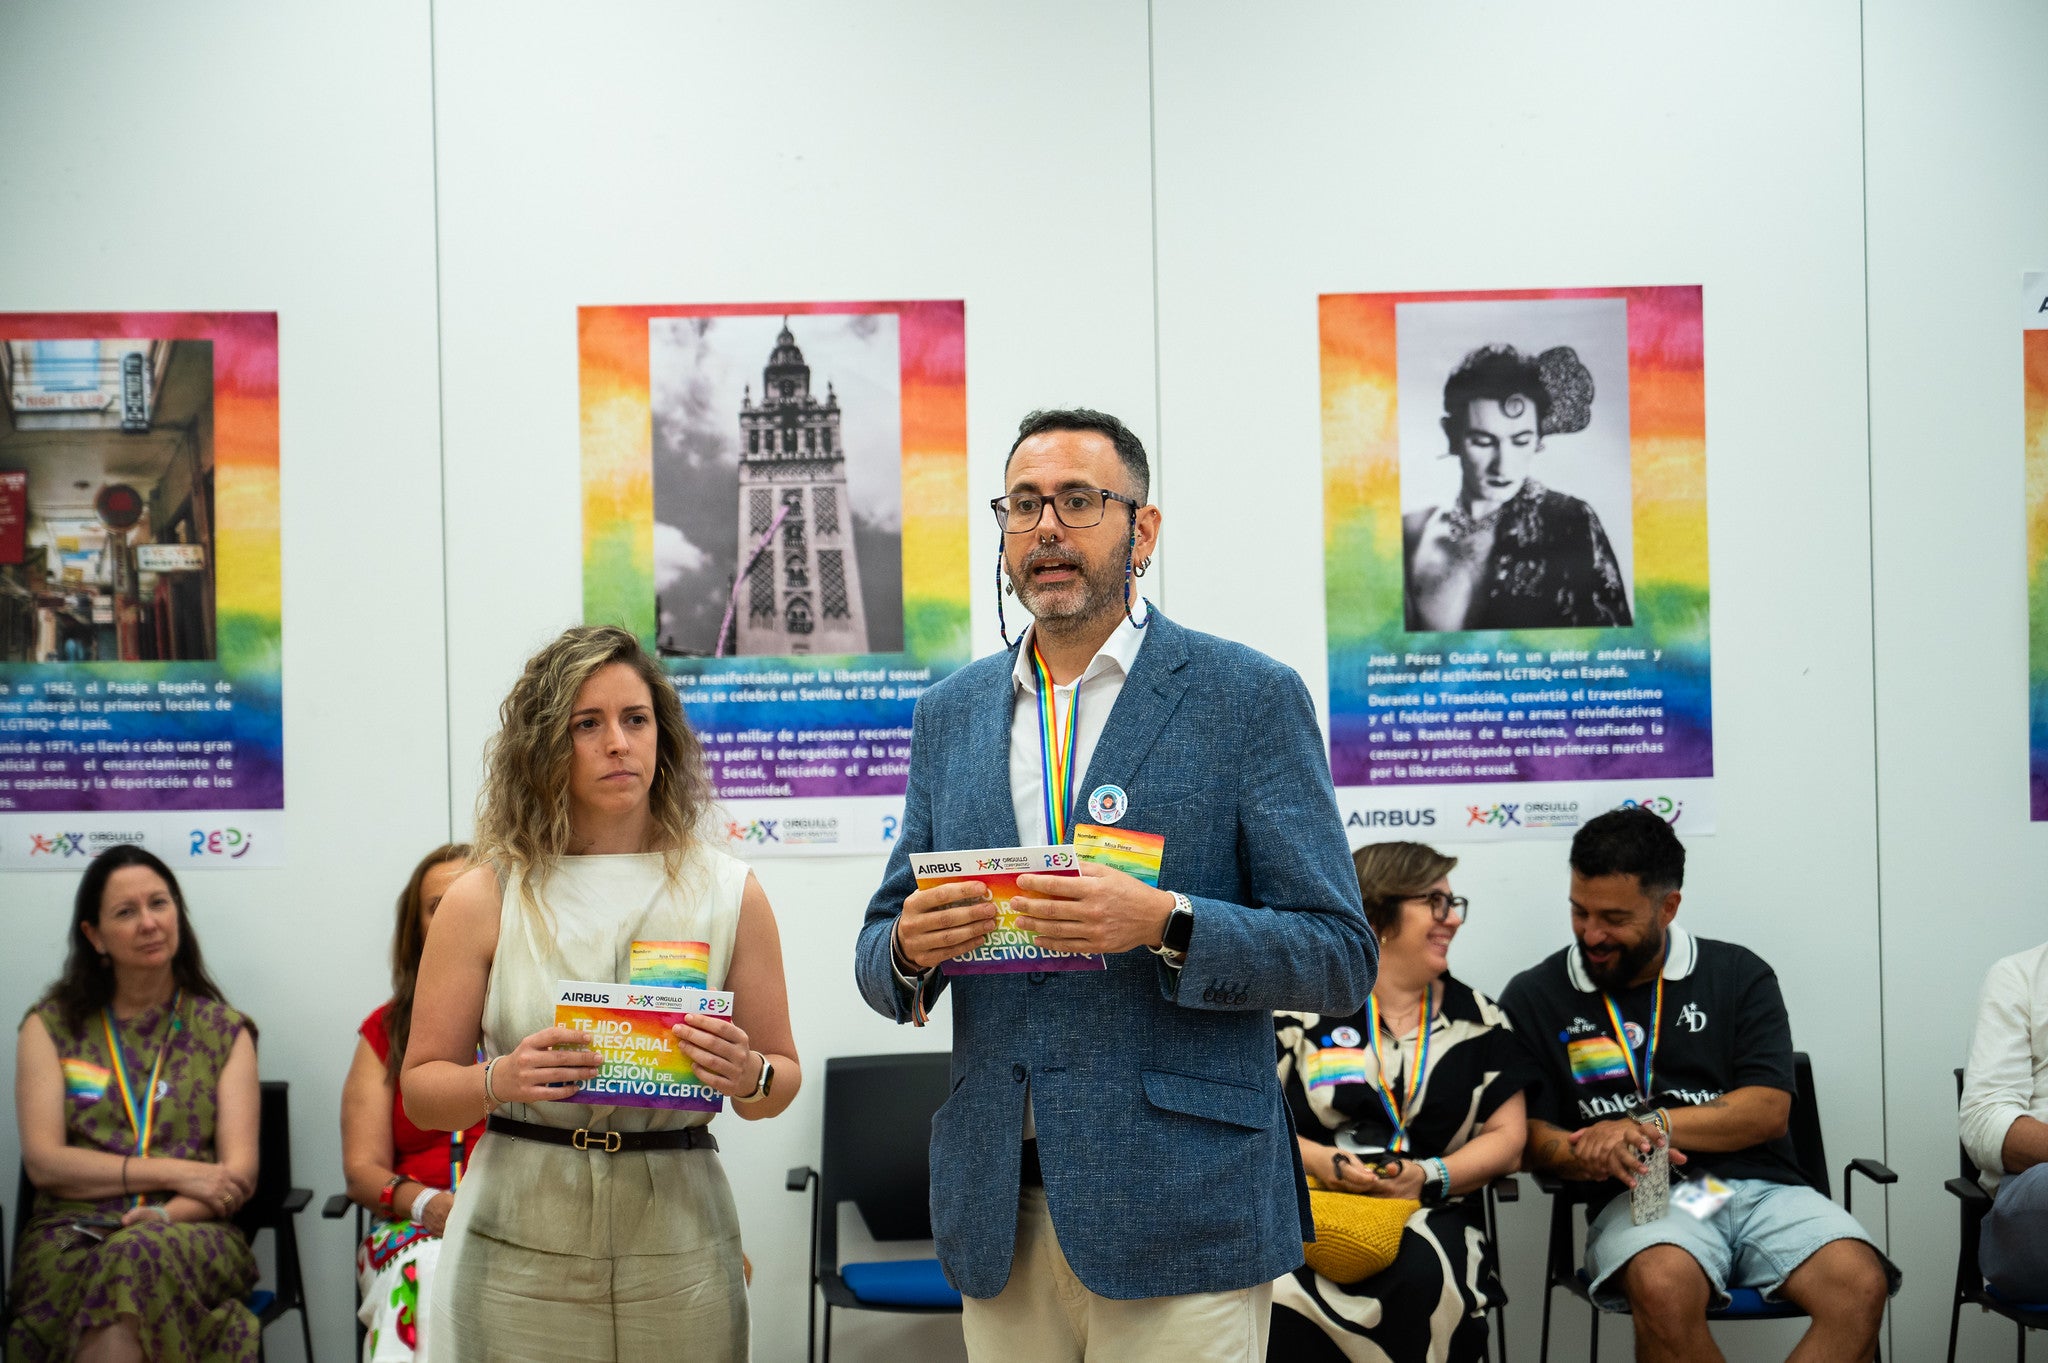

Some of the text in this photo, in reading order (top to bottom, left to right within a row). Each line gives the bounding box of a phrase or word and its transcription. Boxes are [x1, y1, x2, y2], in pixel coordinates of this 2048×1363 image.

[1496, 649, 1518, 664] fue
[1526, 652, 1543, 663] un
[1549, 650, 1589, 664] pintor
[1597, 647, 1647, 661] andaluz
[1652, 649, 1663, 662] y
[700, 671, 790, 686] manifestación
[792, 672, 815, 686] por
[817, 669, 832, 683] la
[833, 668, 886, 683] libertad
[888, 667, 930, 682] sexual
[1367, 671, 1418, 686] pionero
[1419, 669, 1440, 683] del
[1441, 668, 1502, 683] activismo
[1561, 668, 1579, 680] en
[18, 684, 34, 696] en
[85, 680, 99, 695] el
[106, 681, 149, 697] Pasaje
[214, 680, 232, 694] de
[712, 691, 727, 703] se
[729, 688, 779, 703] celebró
[780, 690, 798, 702] en
[799, 687, 843, 701] Sevilla
[844, 686, 859, 700] el
[860, 686, 878, 700] 25
[879, 685, 896, 700] de
[1368, 693, 1420, 707] Durante
[1423, 691, 1437, 706] la
[1571, 688, 1585, 702] el
[1587, 687, 1664, 701] travestismo
[80, 700, 100, 712] los
[104, 699, 162, 714] primeros
[165, 698, 211, 712] locales
[215, 699, 232, 711] de
[59, 717, 80, 731] del
[1368, 705, 1665, 727] y el folclore andaluz en armas reivindicativas
[716, 732, 735, 744] un
[736, 728, 775, 743] millar
[777, 728, 795, 742] de
[797, 729, 856, 744] personas
[1368, 731, 1387, 743] en
[1391, 729, 1412, 742] las
[1417, 727, 1473, 741] Ramblas
[1478, 726, 1496, 740] de
[1574, 723, 1646, 738] desafiando
[1650, 721, 1665, 736] la
[25, 741, 42, 754] de
[80, 741, 96, 753] se
[131, 741, 141, 753] a
[142, 739, 174, 753] cabo
[176, 741, 201, 753] una
[202, 741, 232, 755] gran
[723, 747, 758, 763] pedir
[761, 747, 775, 761] la
[851, 744, 870, 759] de
[871, 744, 886, 759] la
[1369, 740, 1665, 762] censura y participando en las primeras marchas
[42, 760, 66, 772] con
[83, 758, 97, 772] el
[102, 757, 210, 772] encarcelamiento
[215, 757, 233, 771] de
[774, 763, 838, 779] iniciando
[844, 762, 860, 778] el
[1369, 766, 1393, 781] por
[1394, 764, 1408, 778] la
[81, 779, 91, 792] y
[93, 776, 108, 790] la
[192, 775, 210, 789] de
[213, 774, 234, 789] los
[1524, 802, 1578, 813] ORGULLO
[1348, 808, 1436, 828] AIRBUS
[918, 862, 962, 875] AIRBUS
[561, 992, 610, 1005] AIRBUS
[655, 995, 683, 1003] ORGULLO
[572, 1018, 632, 1036] TEJIDO
[593, 1034, 673, 1053] RESARIAL
[646, 1057, 659, 1067] LA
[656, 1072, 675, 1082] DEL
[659, 1083, 723, 1102] LGBTQ+
